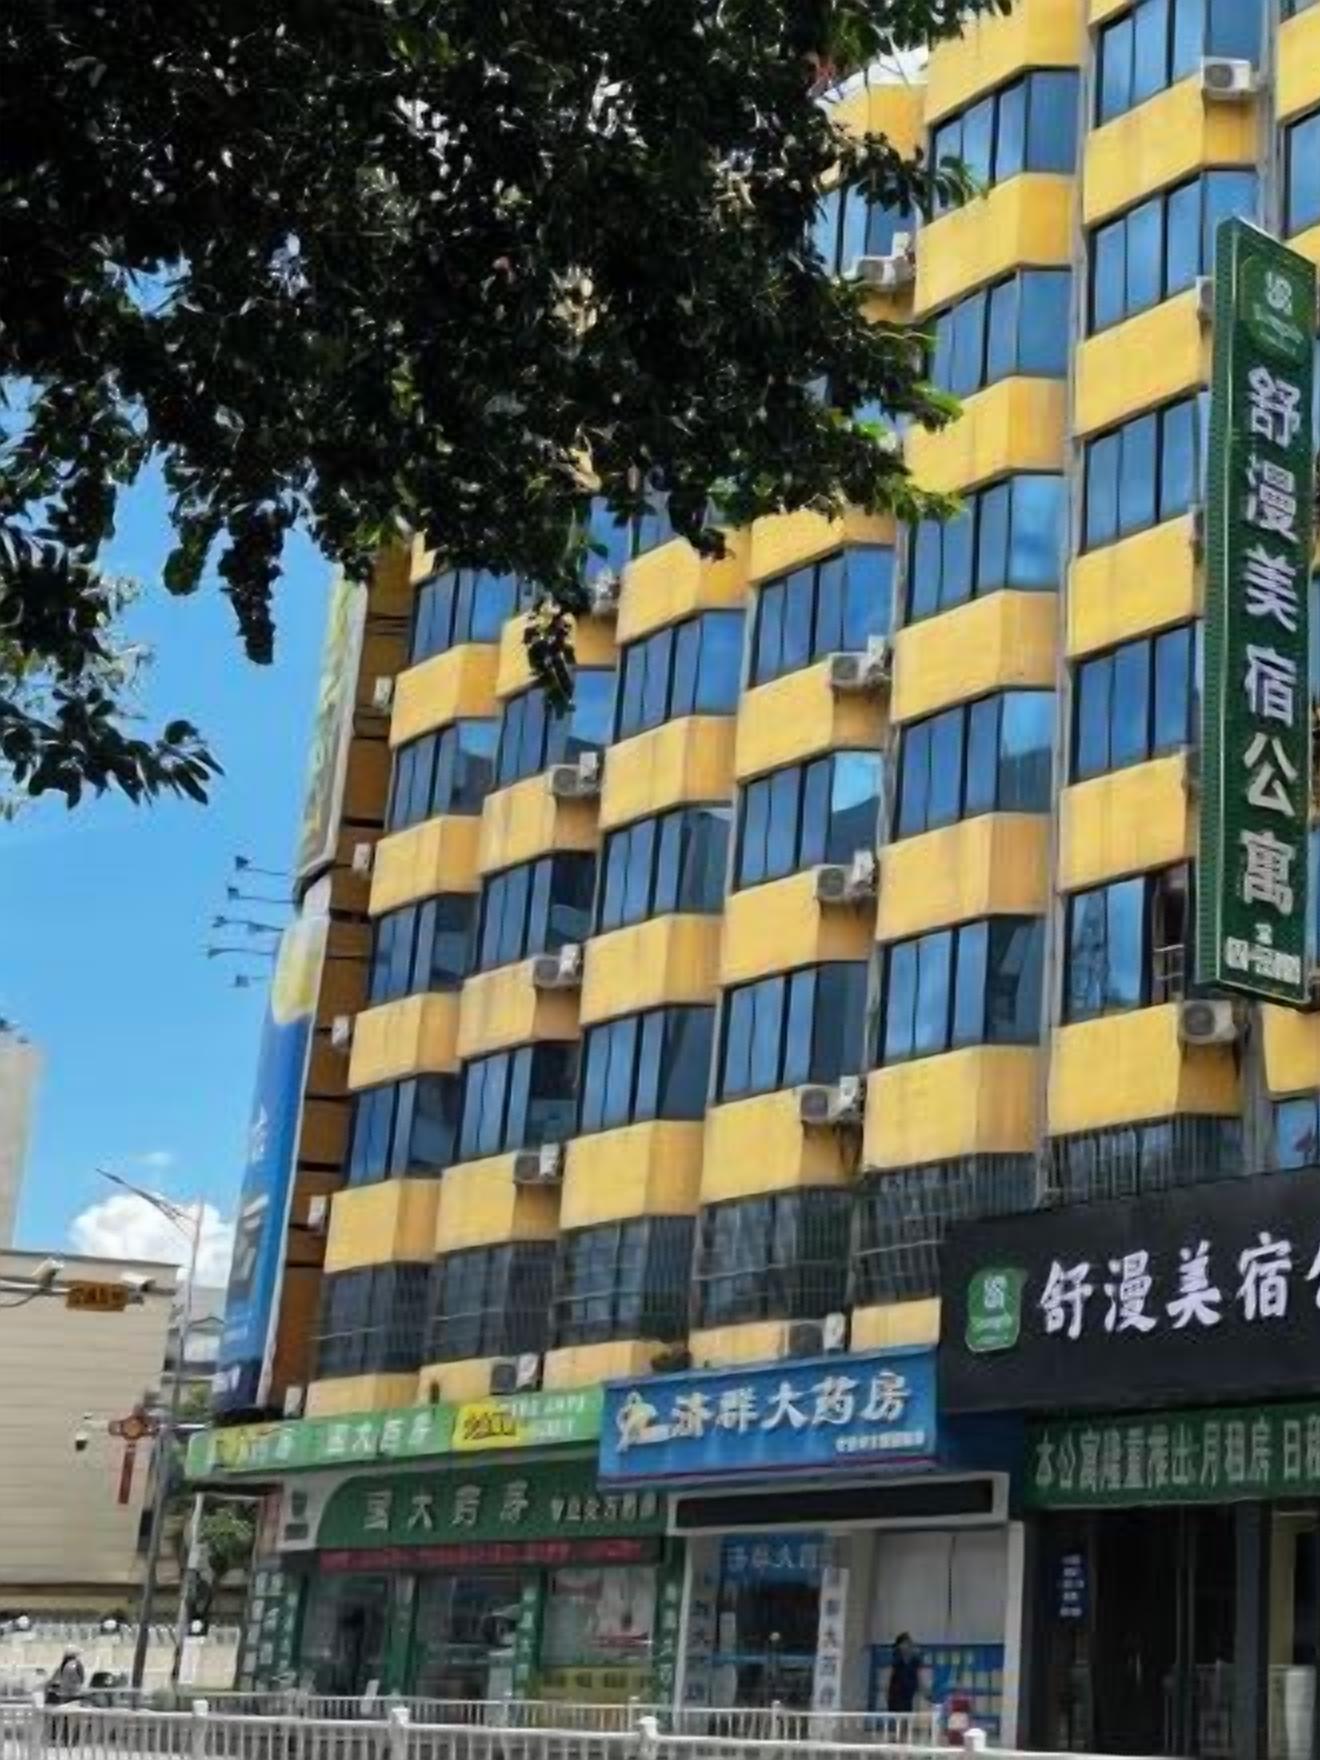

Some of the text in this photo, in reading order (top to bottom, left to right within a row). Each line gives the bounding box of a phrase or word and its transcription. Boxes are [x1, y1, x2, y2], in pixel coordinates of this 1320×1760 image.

[1239, 366, 1302, 916] 舒漫美宿公寓
[669, 1367, 911, 1438] 济群大药房
